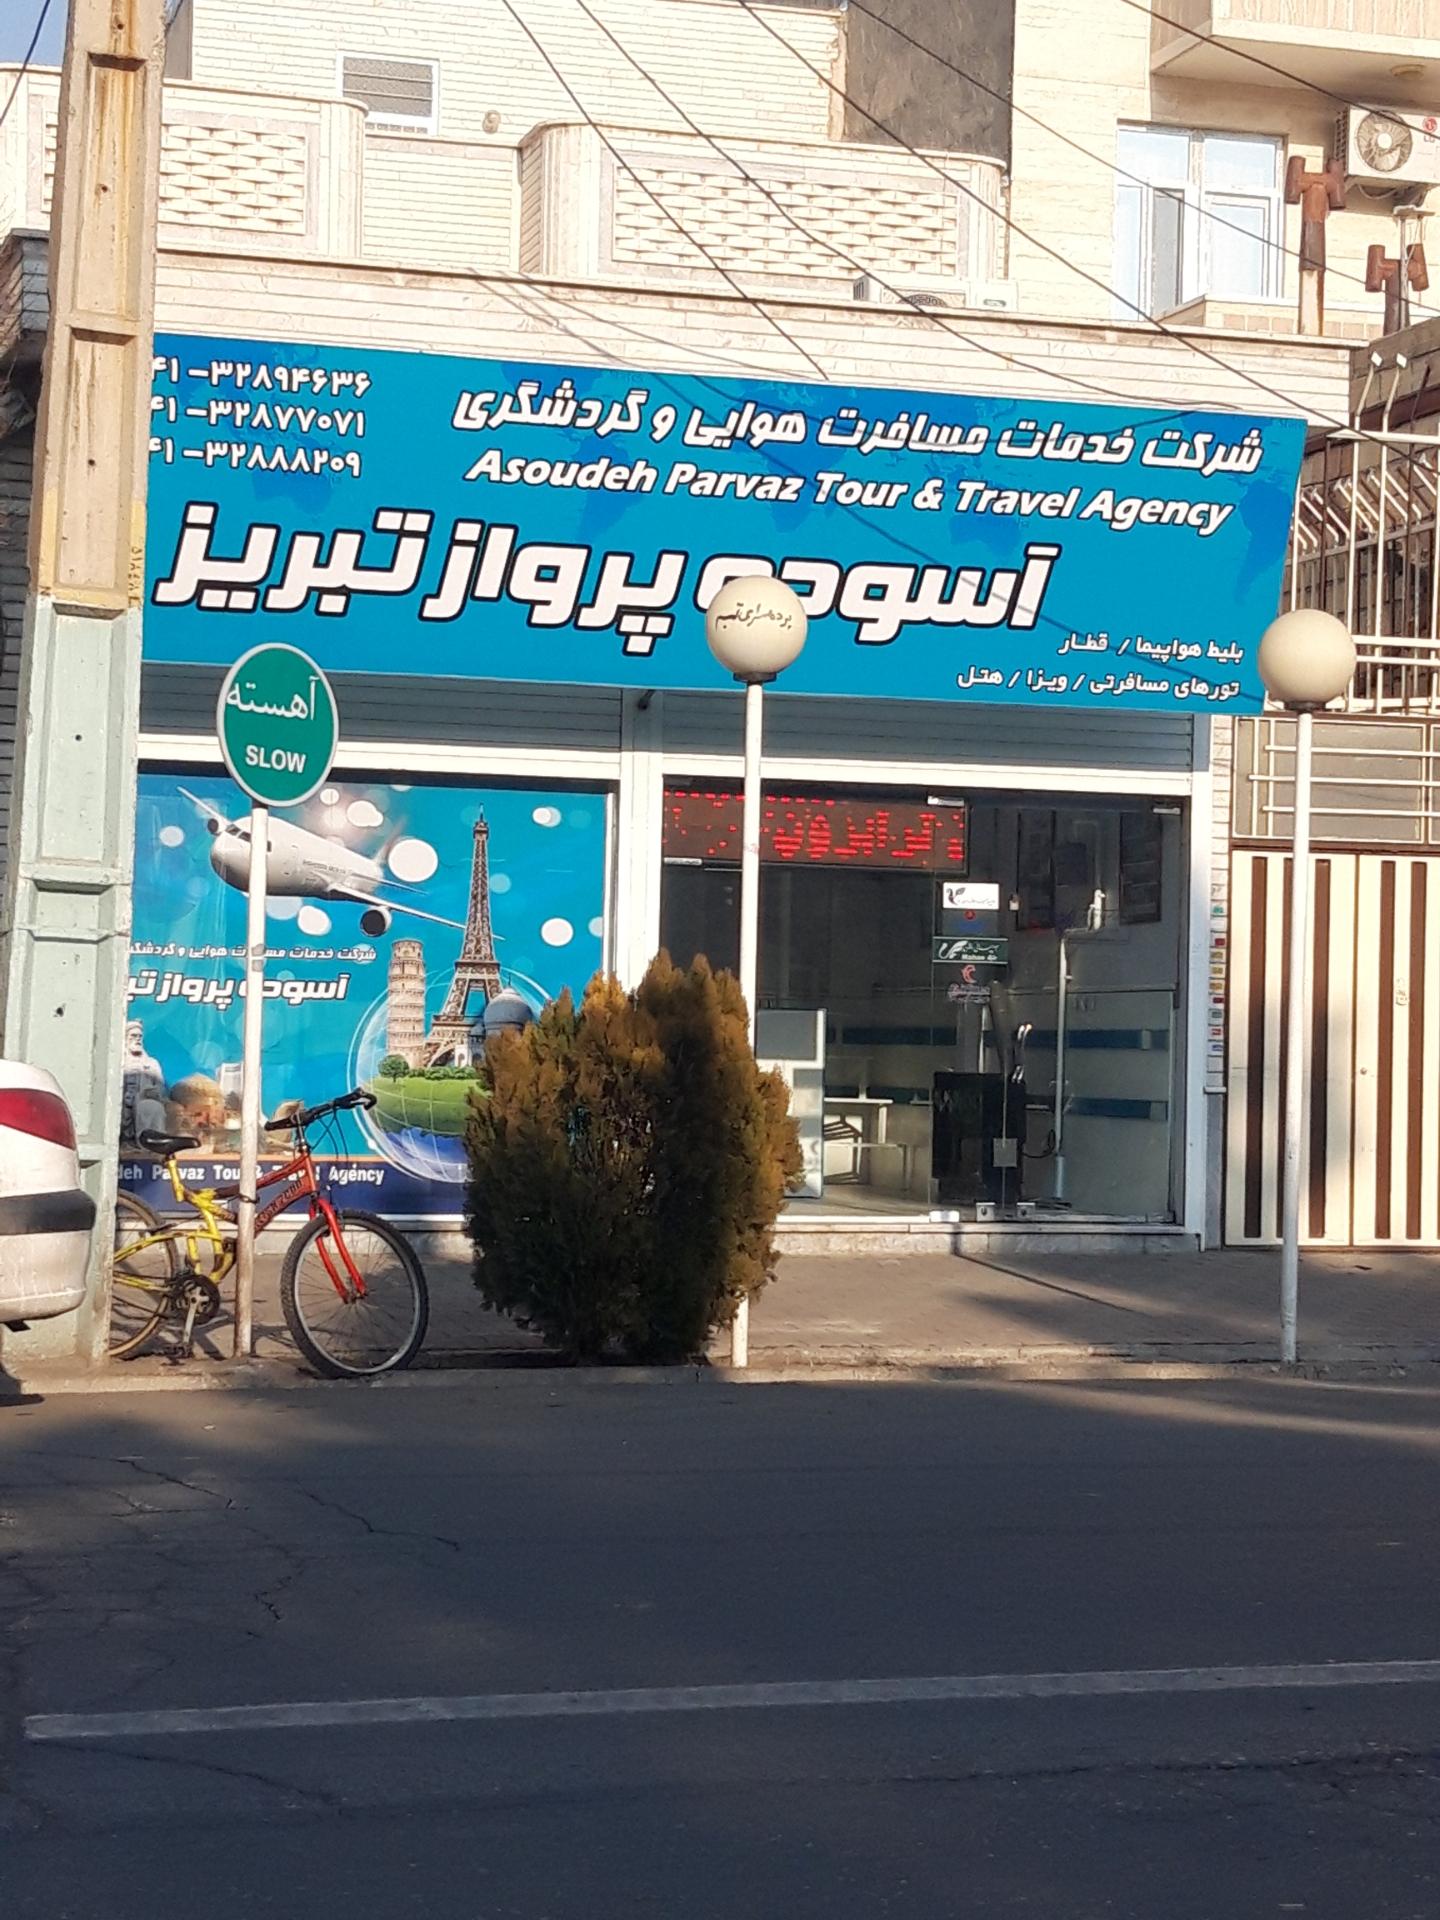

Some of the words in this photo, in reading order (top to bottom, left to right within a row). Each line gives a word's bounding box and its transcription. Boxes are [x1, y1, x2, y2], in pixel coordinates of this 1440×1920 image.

[151, 356, 372, 398] ۴۱-۳۲۸۹۴۶۳۶
[150, 395, 365, 437] ۴۱-۳۲۸۷۷۰۷۱
[453, 379, 649, 437] گردشگری
[652, 404, 677, 442] و
[684, 402, 806, 448] هوایی
[818, 408, 988, 455] مسافرت
[149, 437, 361, 477] ۴۱-۳۲۸۸۸۲۰۹
[997, 421, 1135, 464] خدمات
[1142, 429, 1262, 476] شرکت
[464, 448, 658, 492] Asoudeh
[664, 462, 804, 501] Parvaz
[814, 471, 908, 507] Tour
[913, 478, 944, 511] &
[956, 480, 1081, 518] Travel
[1079, 490, 1234, 536] Agency
[152, 501, 434, 617] تبریز
[419, 519, 688, 656] پرواز
[1058, 632, 1108, 654] قطار
[1136, 637, 1201, 662] هواپیما
[1206, 641, 1243, 663] بلیط
[957, 665, 1003, 688] هتل
[1026, 669, 1068, 692] ویزا
[1089, 673, 1169, 695] مسافرتی
[1174, 677, 1240, 701] تورهای
[226, 675, 320, 721] آهسته
[245, 744, 306, 773] SLOW
[130, 941, 176, 956] گردشگ
[178, 946, 186, 957] و
[188, 944, 228, 958] هوایی
[289, 947, 334, 959] خدمات
[337, 947, 377, 960] شرکت
[155, 971, 236, 1011] پرواز
[152, 1164, 205, 1180] Pavaz
[213, 1164, 241, 1180] Tou
[329, 1165, 385, 1185] Agency
